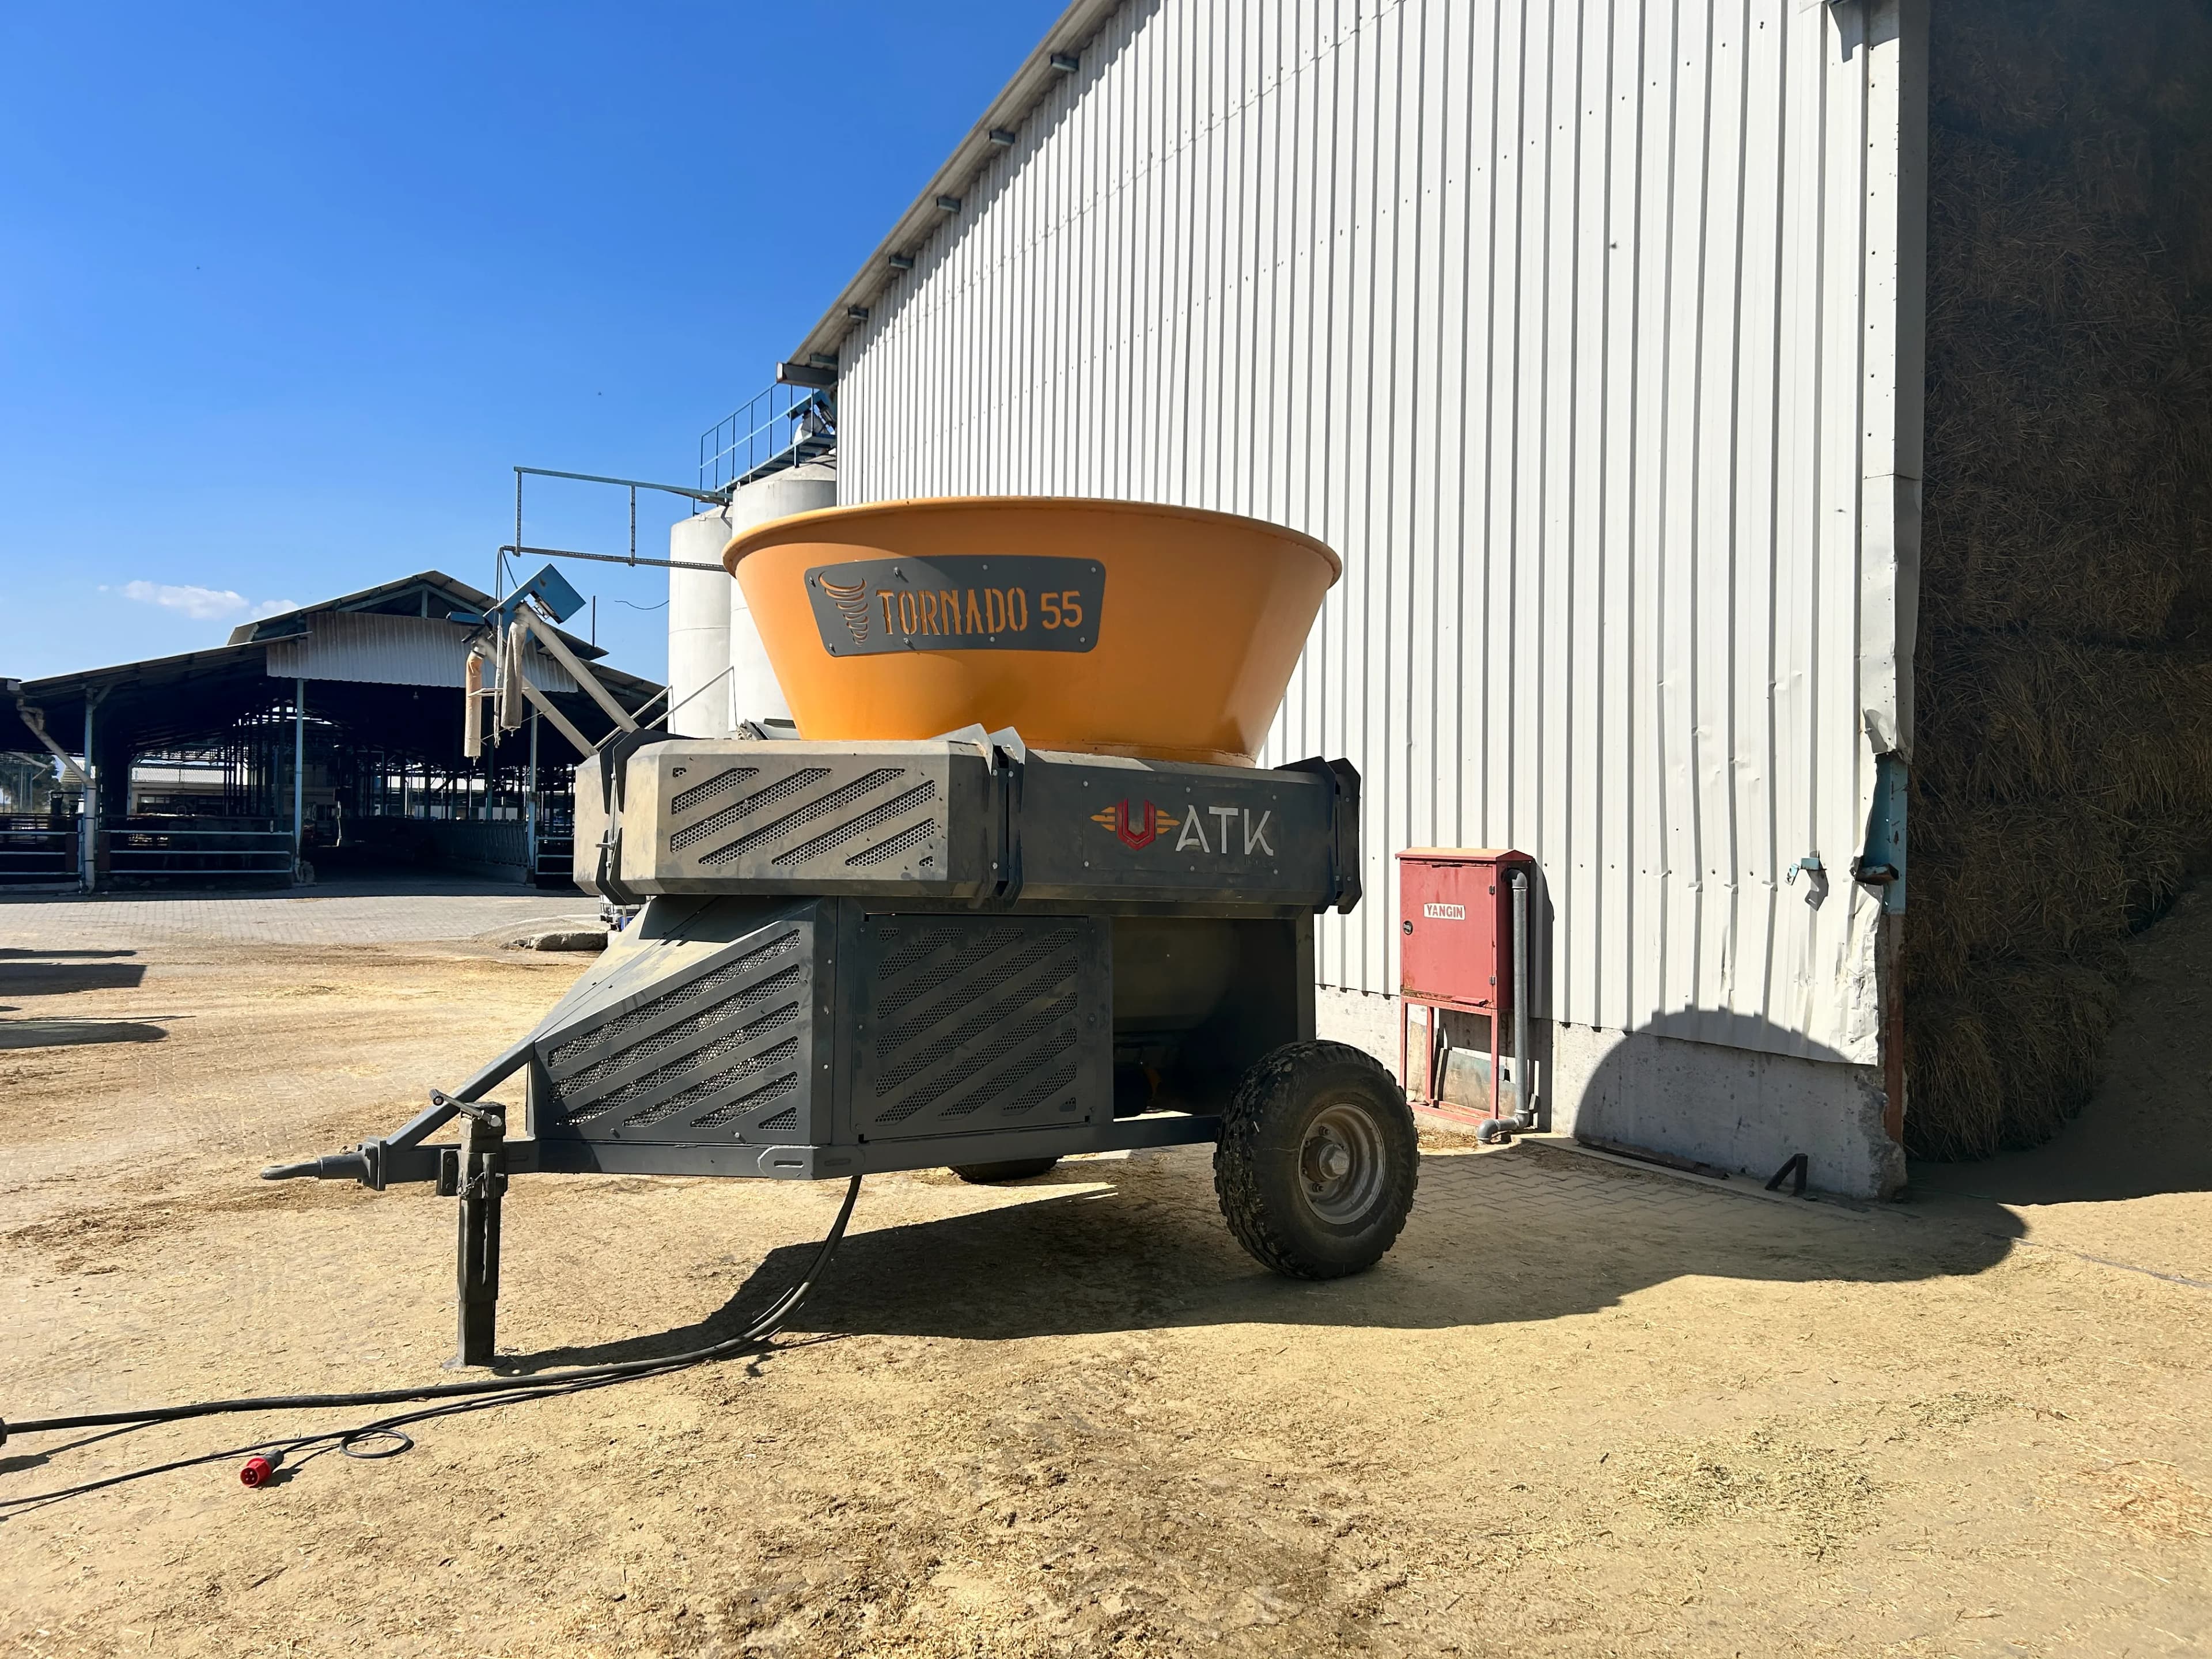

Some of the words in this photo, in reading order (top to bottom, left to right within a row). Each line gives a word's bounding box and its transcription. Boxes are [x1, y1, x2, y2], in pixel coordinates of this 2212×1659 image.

[876, 587, 1028, 635] TORNADO
[1040, 590, 1083, 630] 55
[1175, 805, 1274, 857] ATK
[1427, 904, 1463, 918] YANGIN
